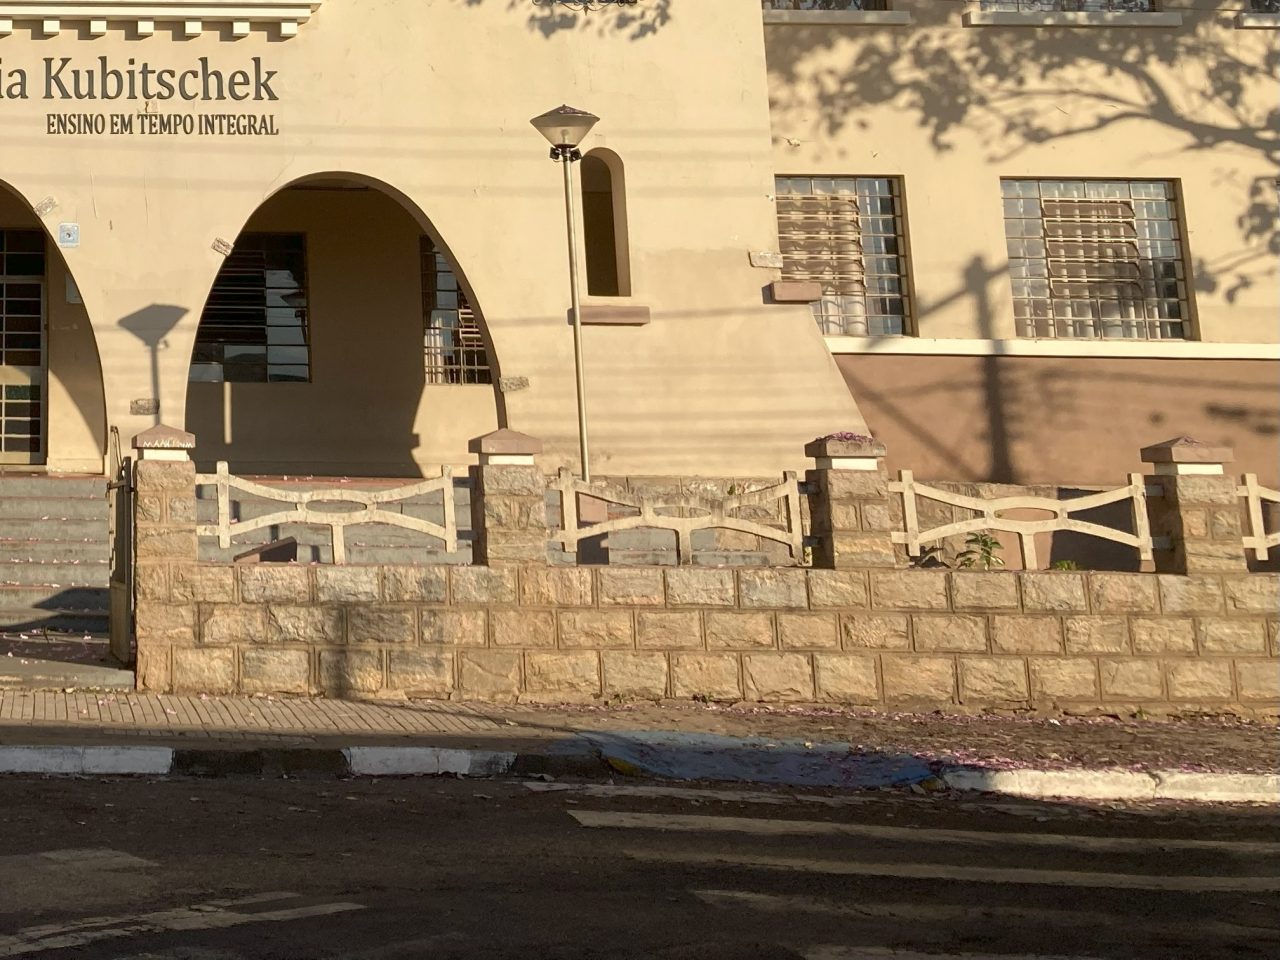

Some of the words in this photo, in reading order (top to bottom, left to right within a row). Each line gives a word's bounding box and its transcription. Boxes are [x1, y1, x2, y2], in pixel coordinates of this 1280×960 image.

[42, 56, 280, 101] Kubitschek
[46, 113, 105, 135] ENSINO
[109, 113, 134, 135] EM
[137, 113, 194, 135] TEMPO
[198, 114, 279, 136] INTEGRAL
